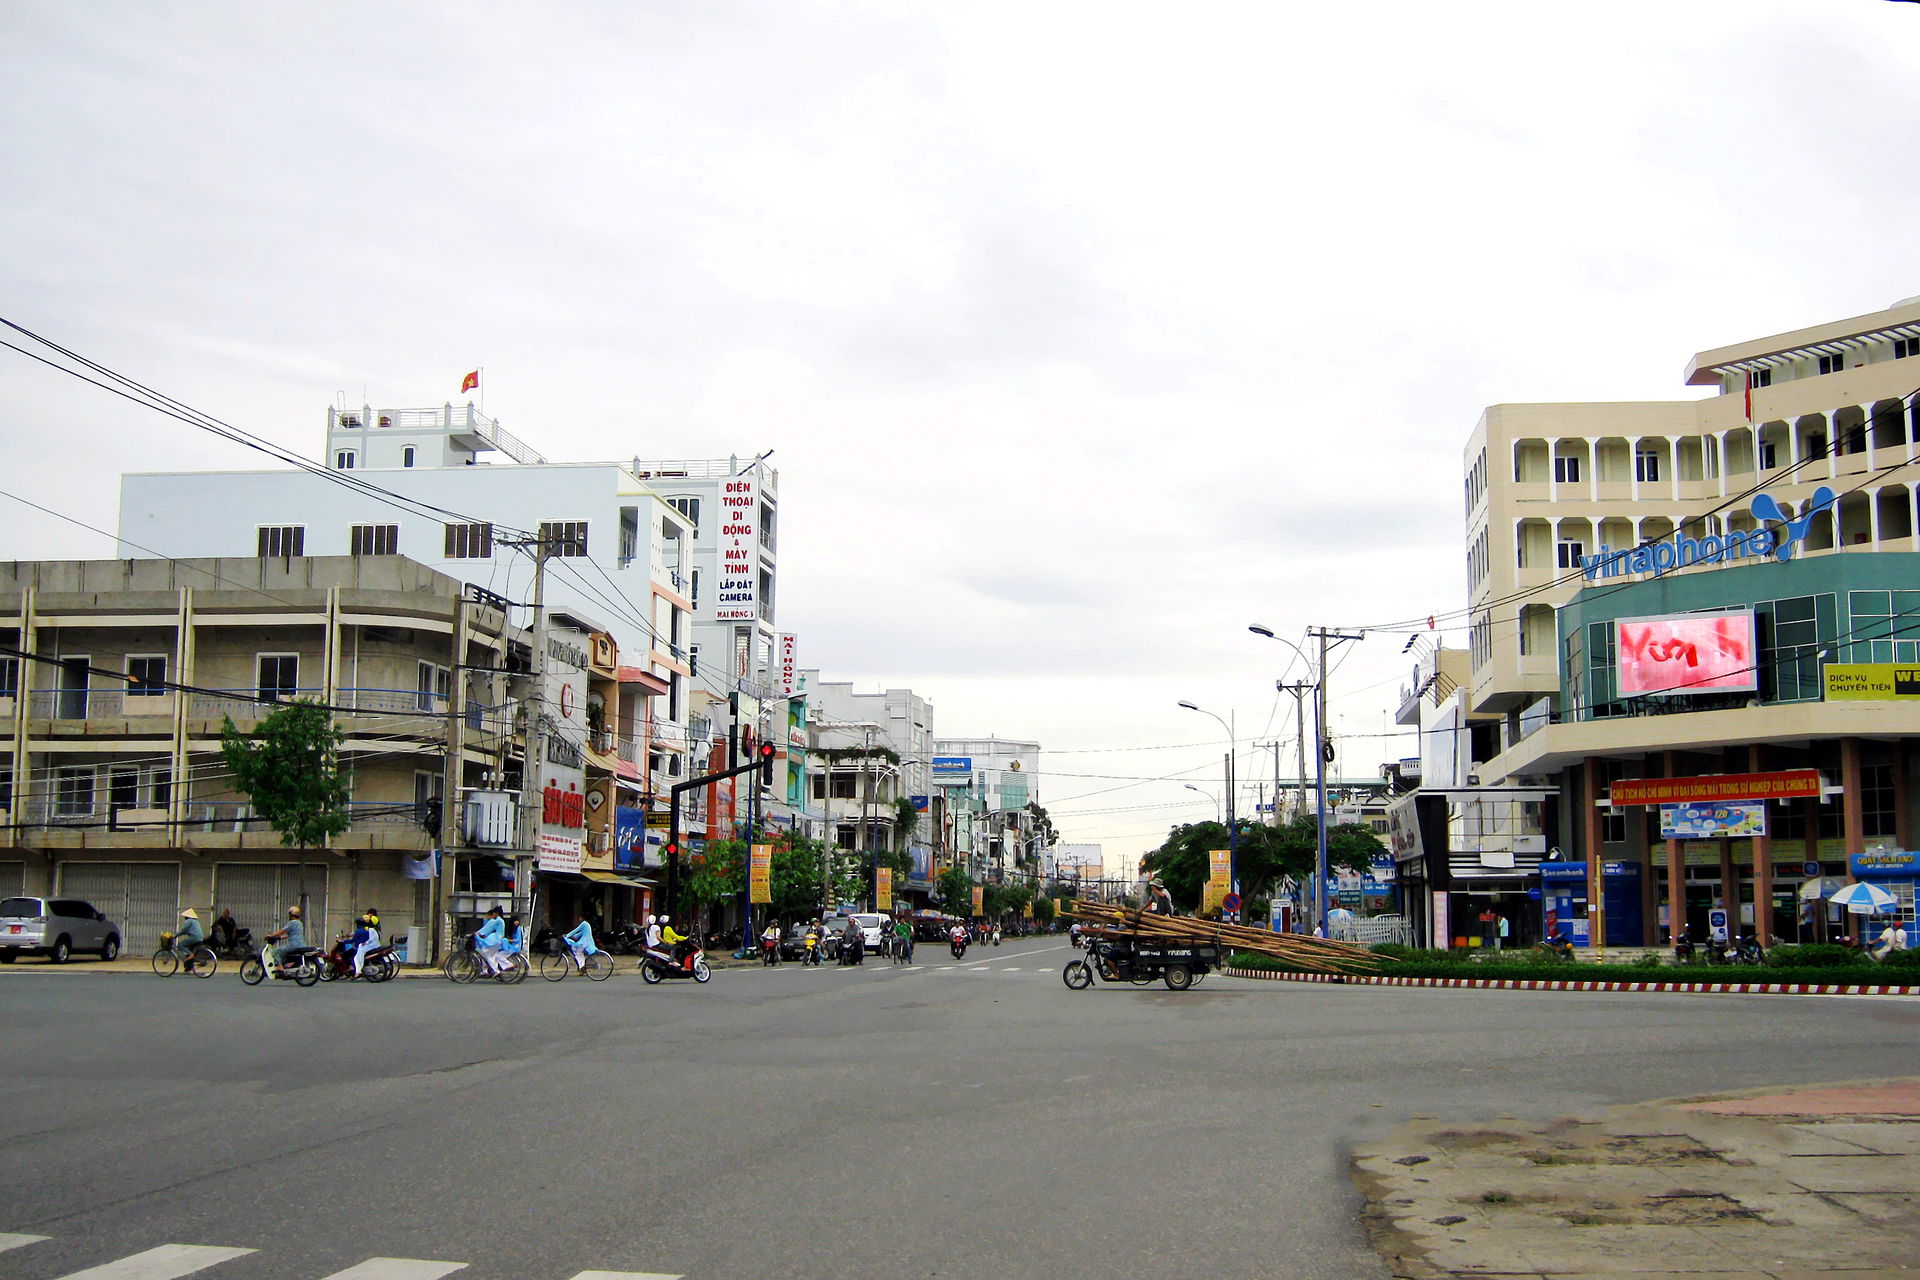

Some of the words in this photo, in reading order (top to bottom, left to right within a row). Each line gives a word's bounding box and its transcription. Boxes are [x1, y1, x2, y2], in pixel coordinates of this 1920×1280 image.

[726, 480, 751, 495] ĐIỆN
[723, 497, 754, 509] THOẠI
[733, 511, 742, 520] DI
[723, 523, 752, 538] ĐỘNG
[726, 547, 748, 559] MÁY
[1577, 527, 1774, 580] vinaphone
[724, 561, 749, 574] TÍNH
[719, 593, 753, 601] CAMERA
[783, 636, 794, 655] MAI
[1542, 868, 1584, 877] Sacombank
